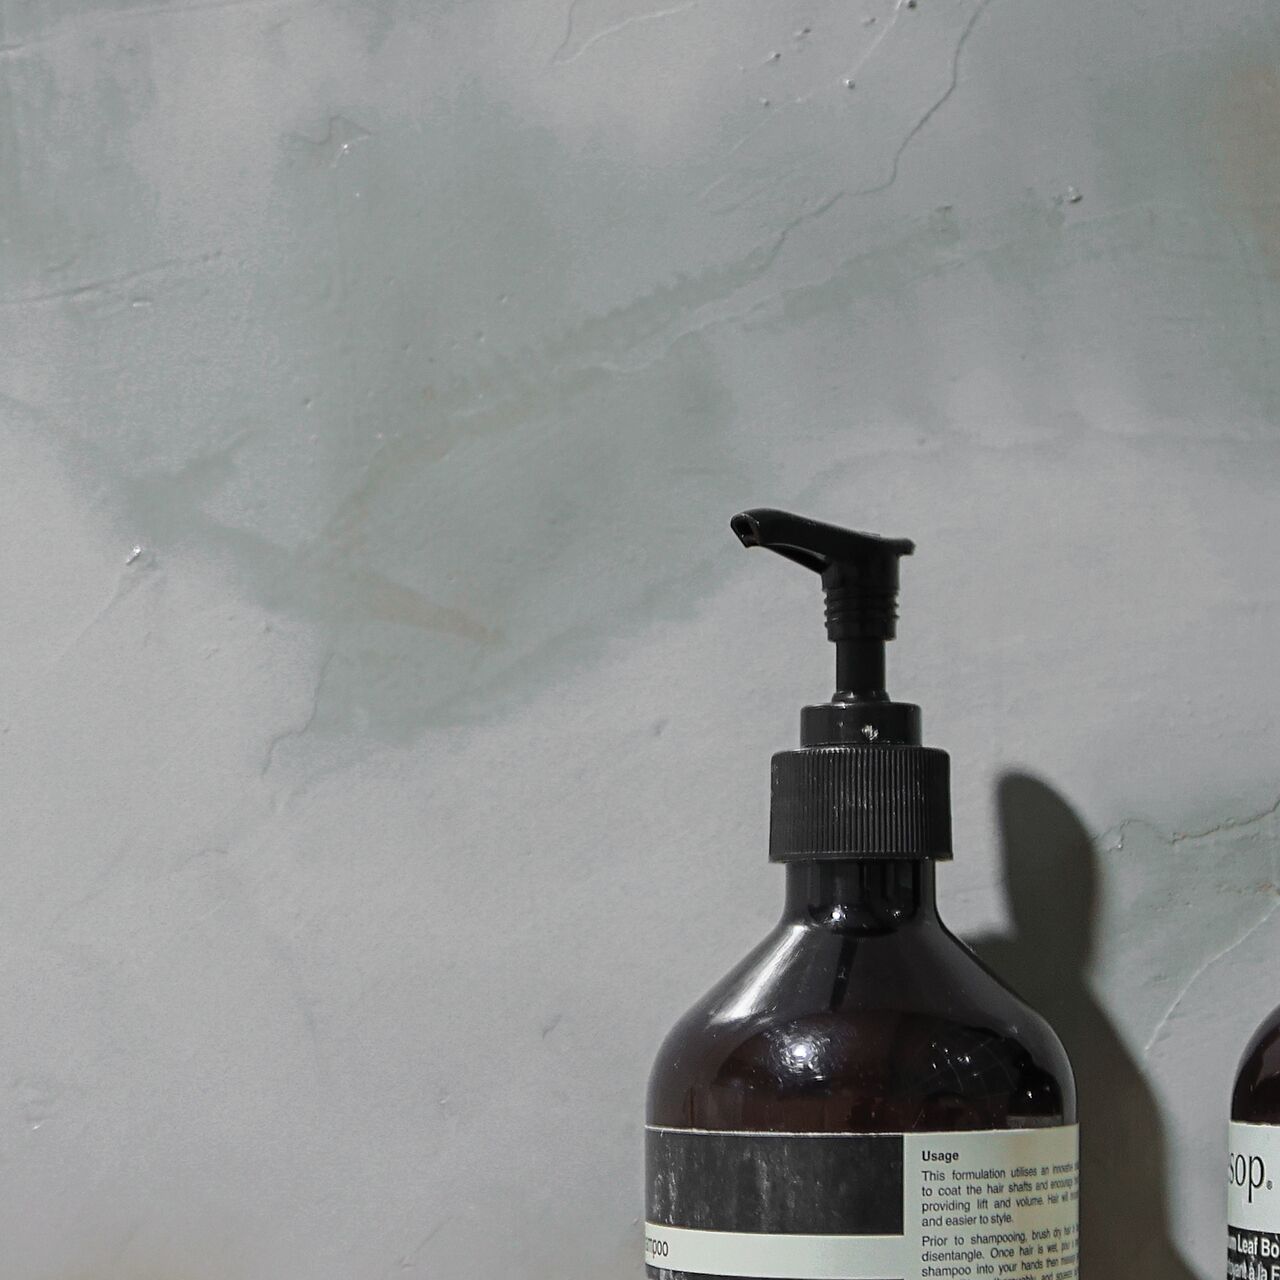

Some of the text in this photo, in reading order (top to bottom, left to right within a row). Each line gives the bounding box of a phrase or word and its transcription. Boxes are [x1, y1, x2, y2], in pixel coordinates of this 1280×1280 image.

[922, 1150, 959, 1163] Usage
[922, 1170, 945, 1181] This
[952, 1168, 1006, 1180] formulation
[1011, 1166, 1037, 1178] utilises
[922, 1186, 933, 1197] to
[938, 1186, 961, 1196] coat
[966, 1185, 982, 1195] the
[987, 1183, 1004, 1194] hair
[1009, 1181, 1032, 1192] shafts
[1035, 1179, 1048, 1190] and
[922, 1200, 971, 1214] providing
[977, 1199, 988, 1209] lift
[994, 1197, 1011, 1208] and
[922, 1213, 1014, 1227] and easier to style.
[922, 1236, 948, 1247] Prior
[954, 1236, 964, 1246] to
[970, 1231, 1027, 1246] shampooing,
[1031, 1229, 1051, 1240] brush
[1237, 1233, 1258, 1256] Leaf
[922, 1249, 985, 1262] disentangle.
[990, 1247, 1015, 1259] Once
[1020, 1244, 1034, 1256] hair
[1037, 1244, 1044, 1255] is
[922, 1265, 971, 1278] shampoo
[976, 1264, 994, 1275] into
[998, 1263, 1017, 1276] your
[1021, 1259, 1043, 1271] hands
